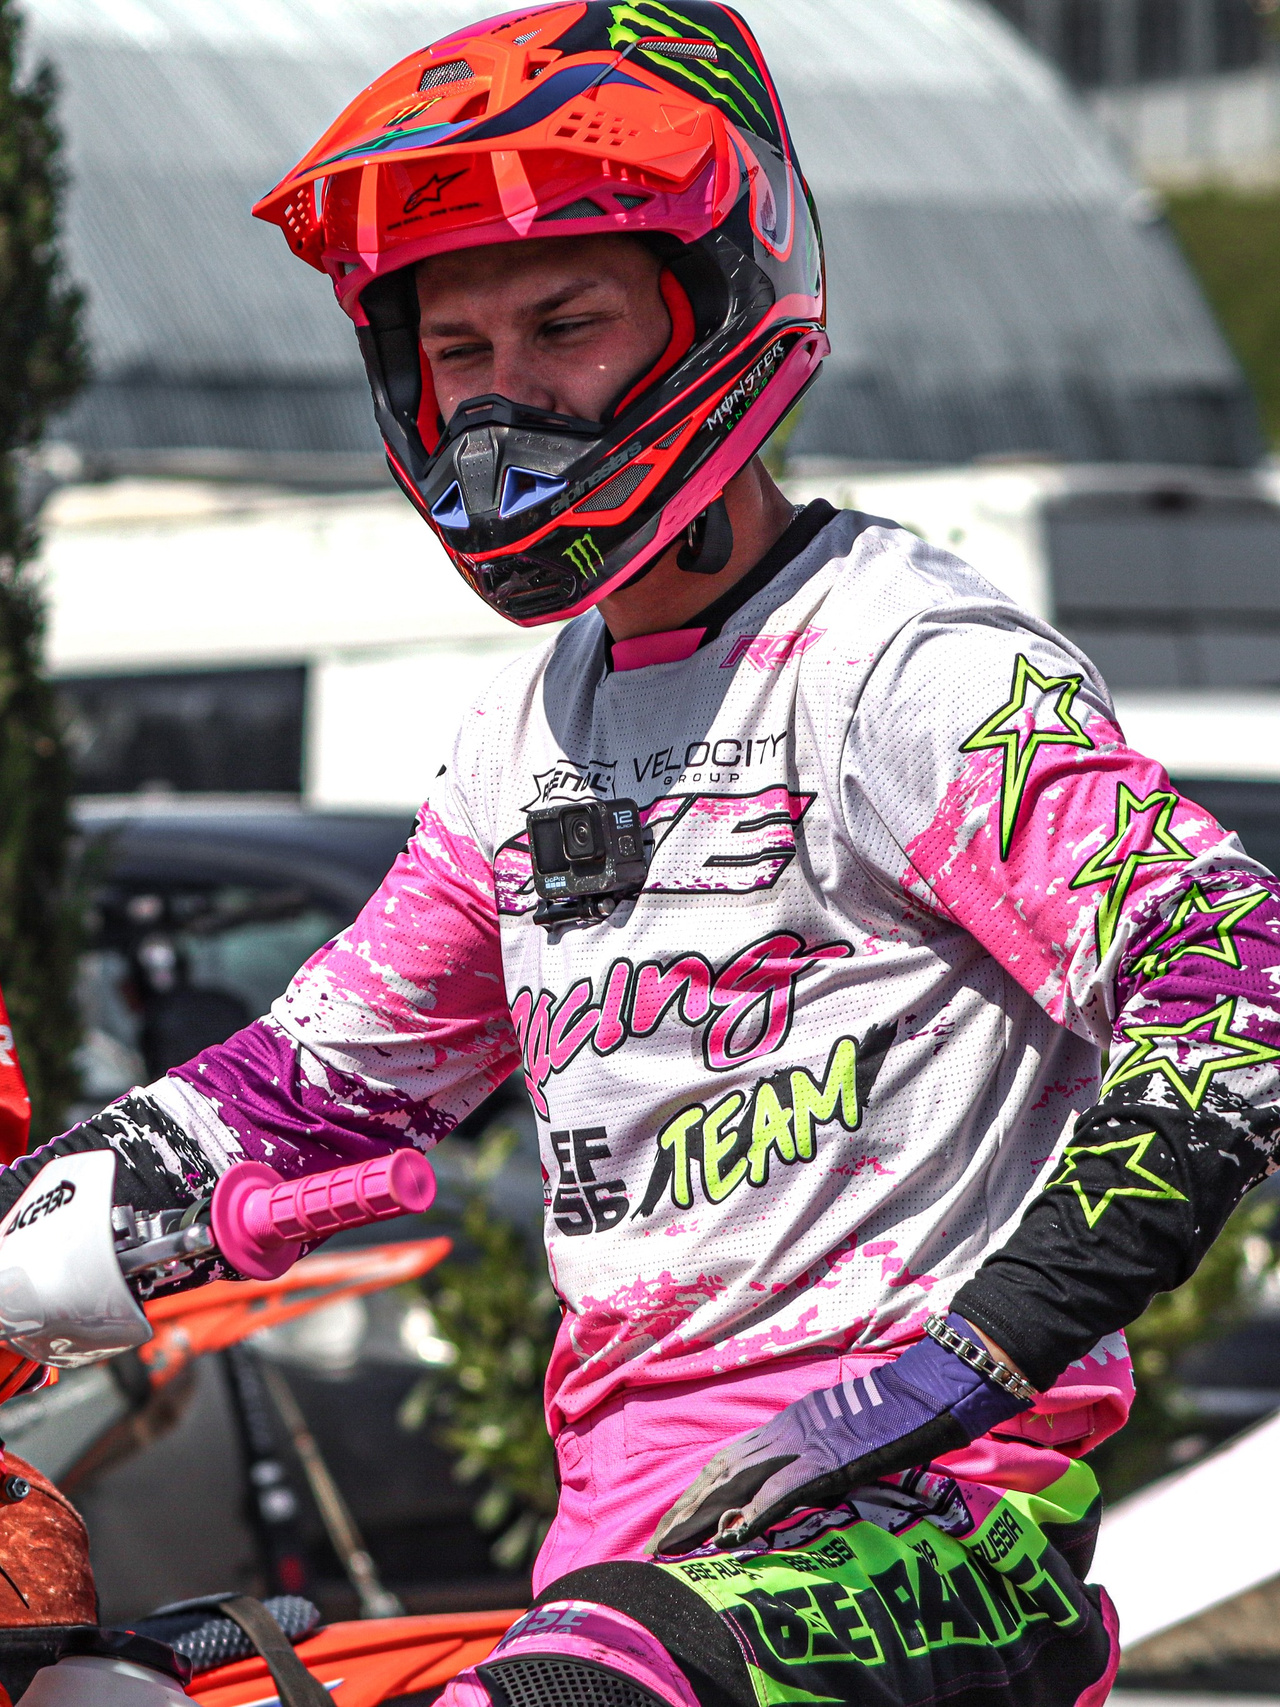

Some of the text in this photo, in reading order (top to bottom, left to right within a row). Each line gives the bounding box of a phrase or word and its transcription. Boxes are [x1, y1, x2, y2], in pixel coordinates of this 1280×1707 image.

[633, 730, 788, 783] VELOCITY
[663, 772, 740, 786] GROUP
[612, 809, 634, 825] 12
[544, 874, 566, 883] GoPro
[657, 1034, 863, 1210] TEAM
[550, 1125, 613, 1185] EF
[552, 1178, 631, 1237] 56
[679, 1562, 719, 1583] BSE
